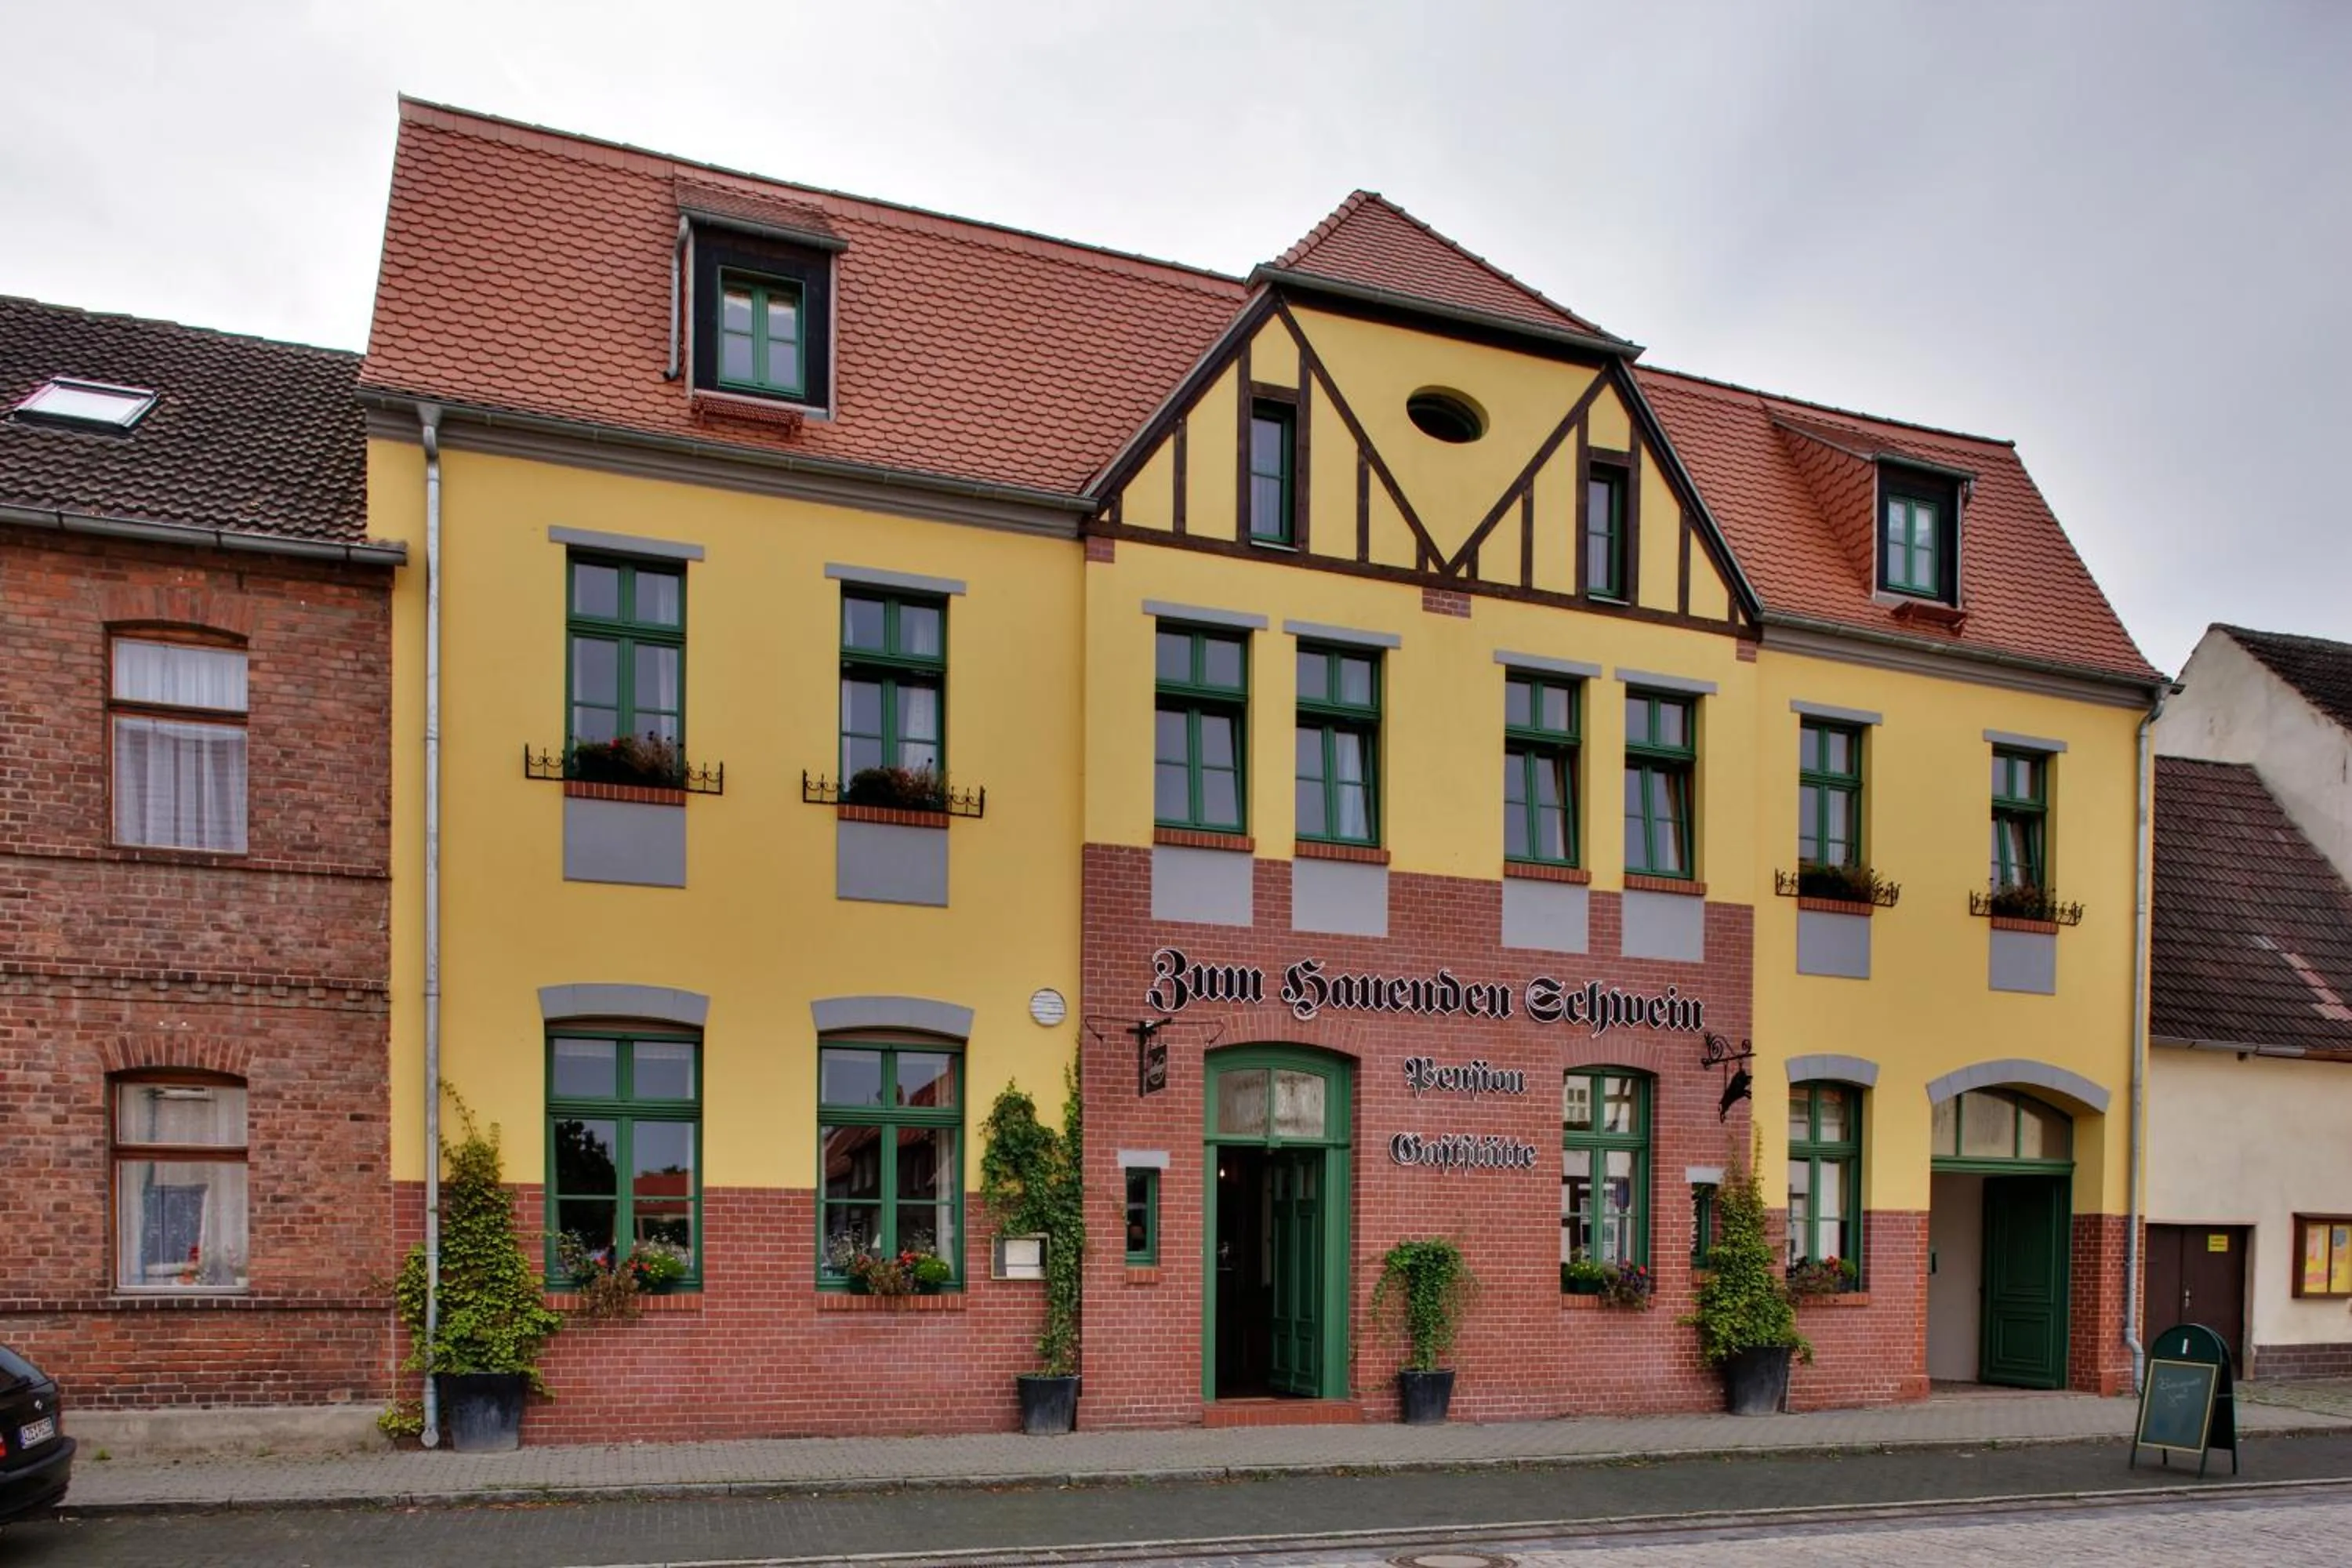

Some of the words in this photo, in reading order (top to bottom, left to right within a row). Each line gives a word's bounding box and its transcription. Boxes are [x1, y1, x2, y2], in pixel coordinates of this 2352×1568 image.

[1146, 947, 1266, 1013] Zum
[1280, 957, 1515, 1021] Hauenden
[1526, 975, 1705, 1039] Schwein
